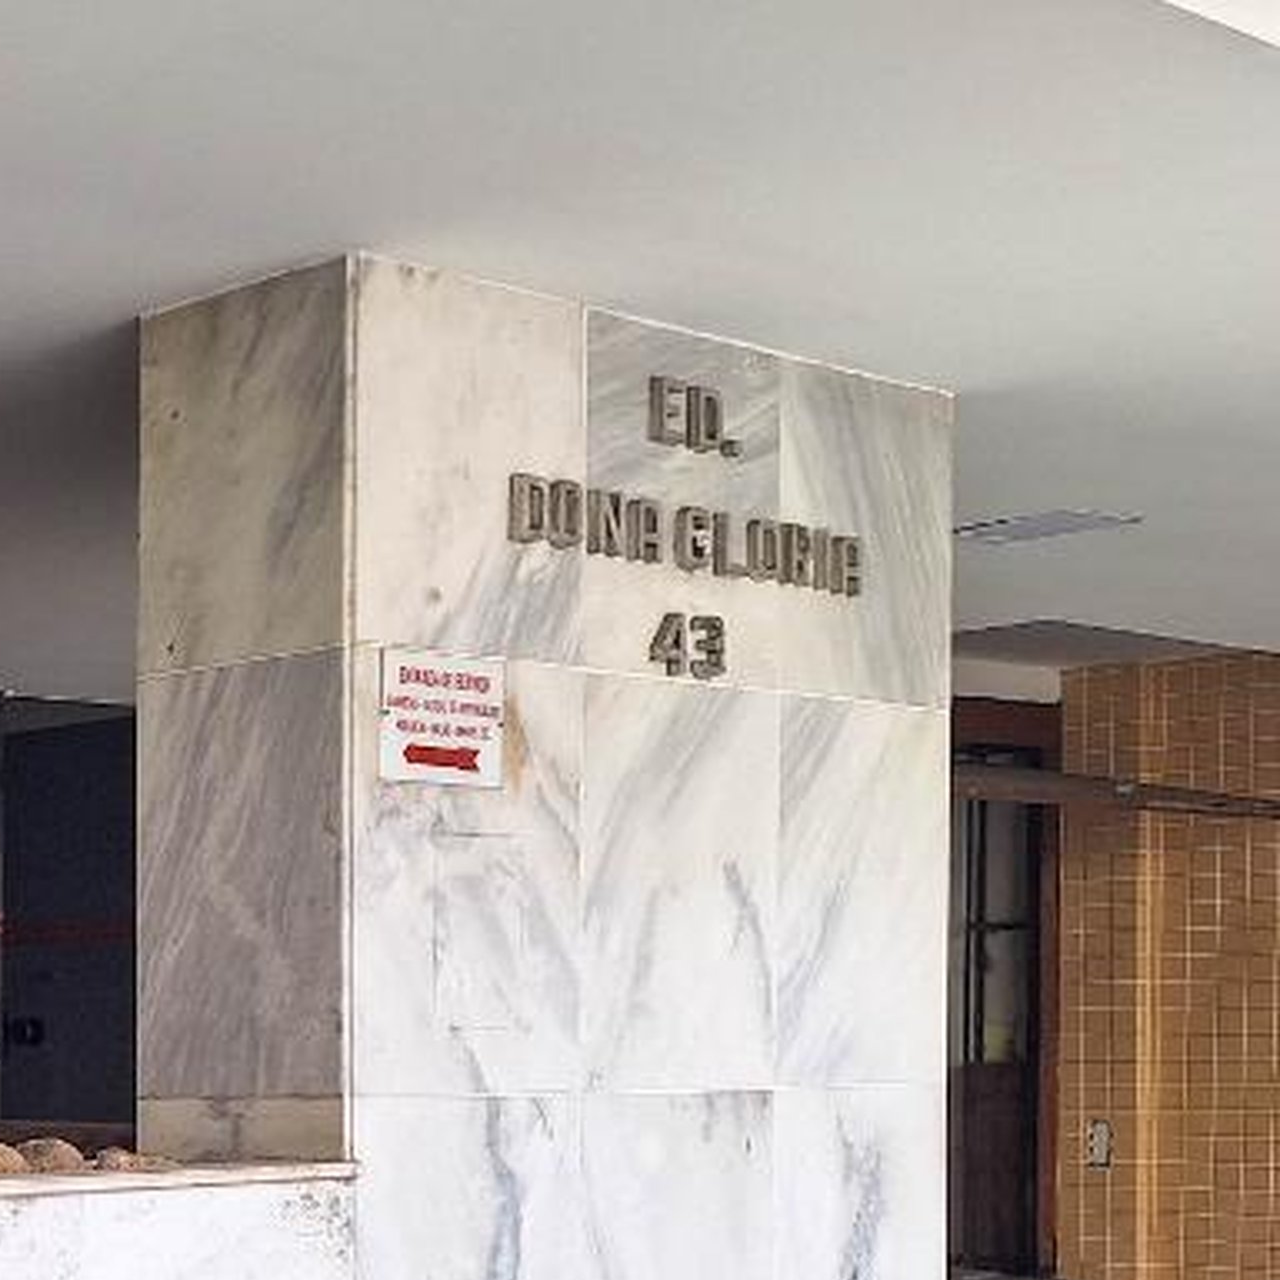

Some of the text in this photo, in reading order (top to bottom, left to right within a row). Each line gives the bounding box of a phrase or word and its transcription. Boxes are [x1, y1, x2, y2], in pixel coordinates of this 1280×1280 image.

[648, 375, 741, 457] ED.
[507, 472, 862, 598] DONA GLORIA
[648, 612, 727, 680] 43
